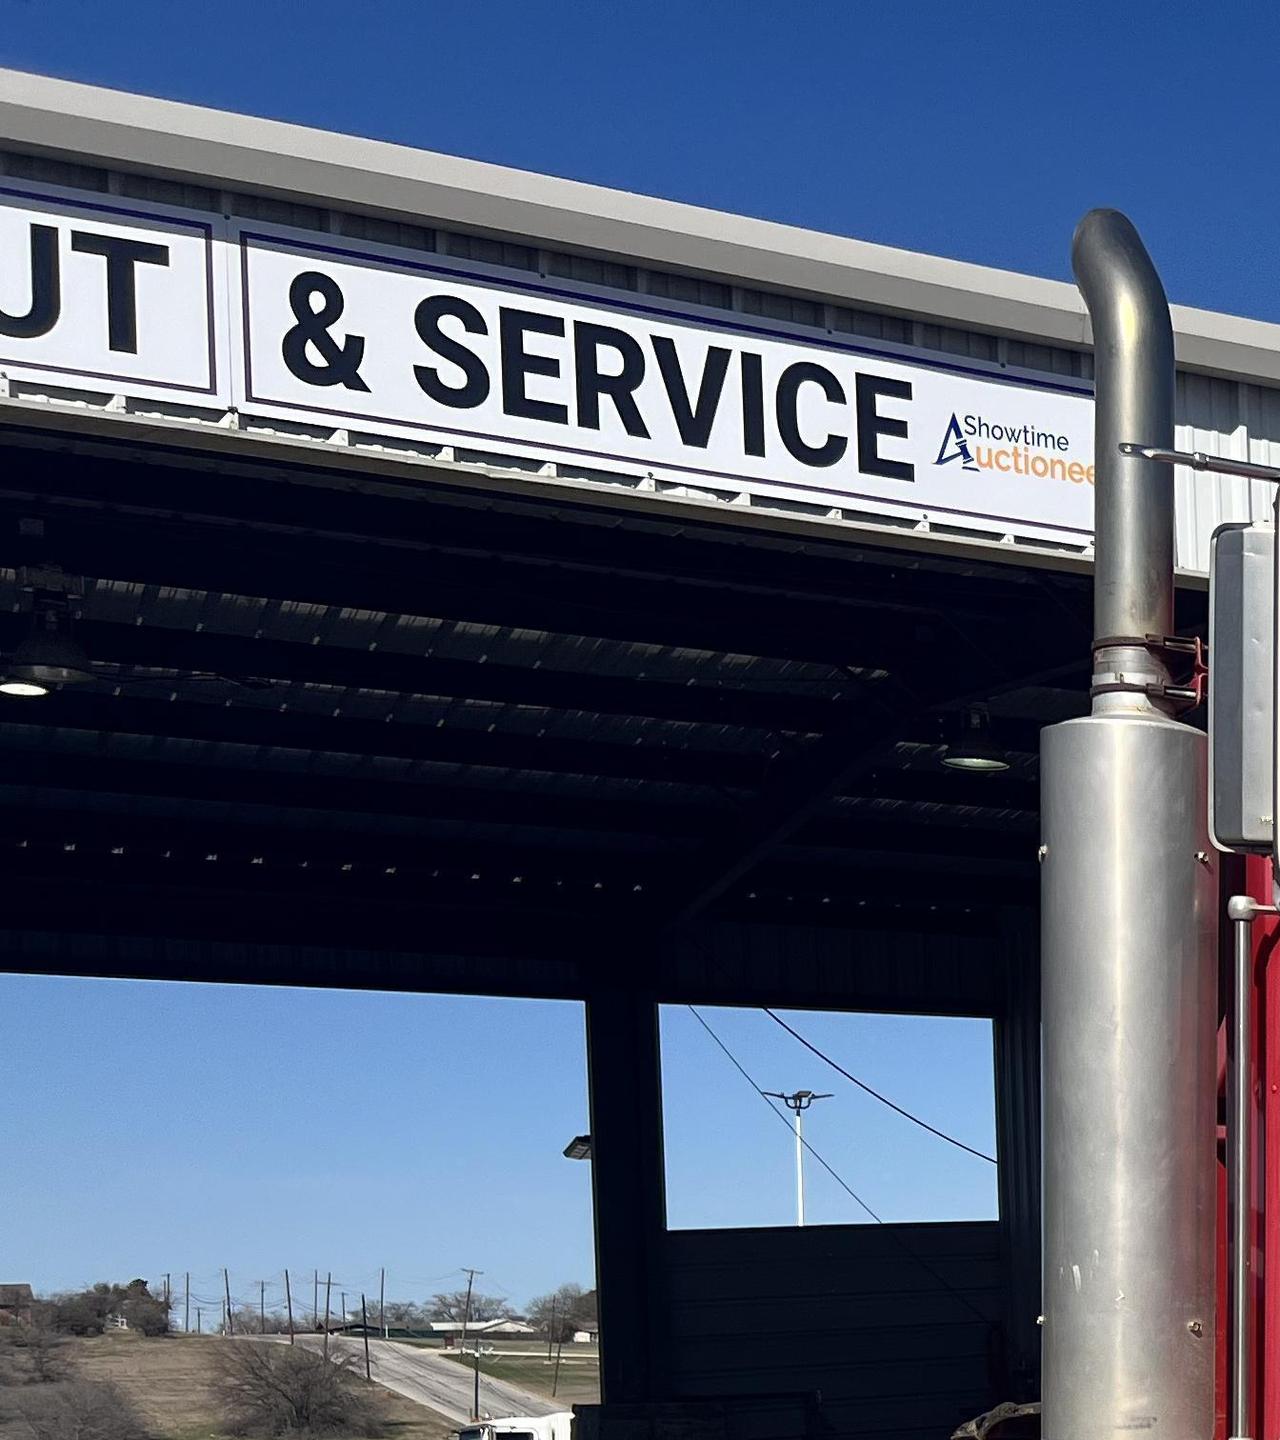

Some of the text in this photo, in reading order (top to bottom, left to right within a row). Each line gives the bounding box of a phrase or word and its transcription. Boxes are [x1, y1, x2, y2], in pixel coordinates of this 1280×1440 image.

[281, 270, 372, 393] &
[412, 294, 916, 483] SERVICE
[964, 414, 1069, 452] Showtime
